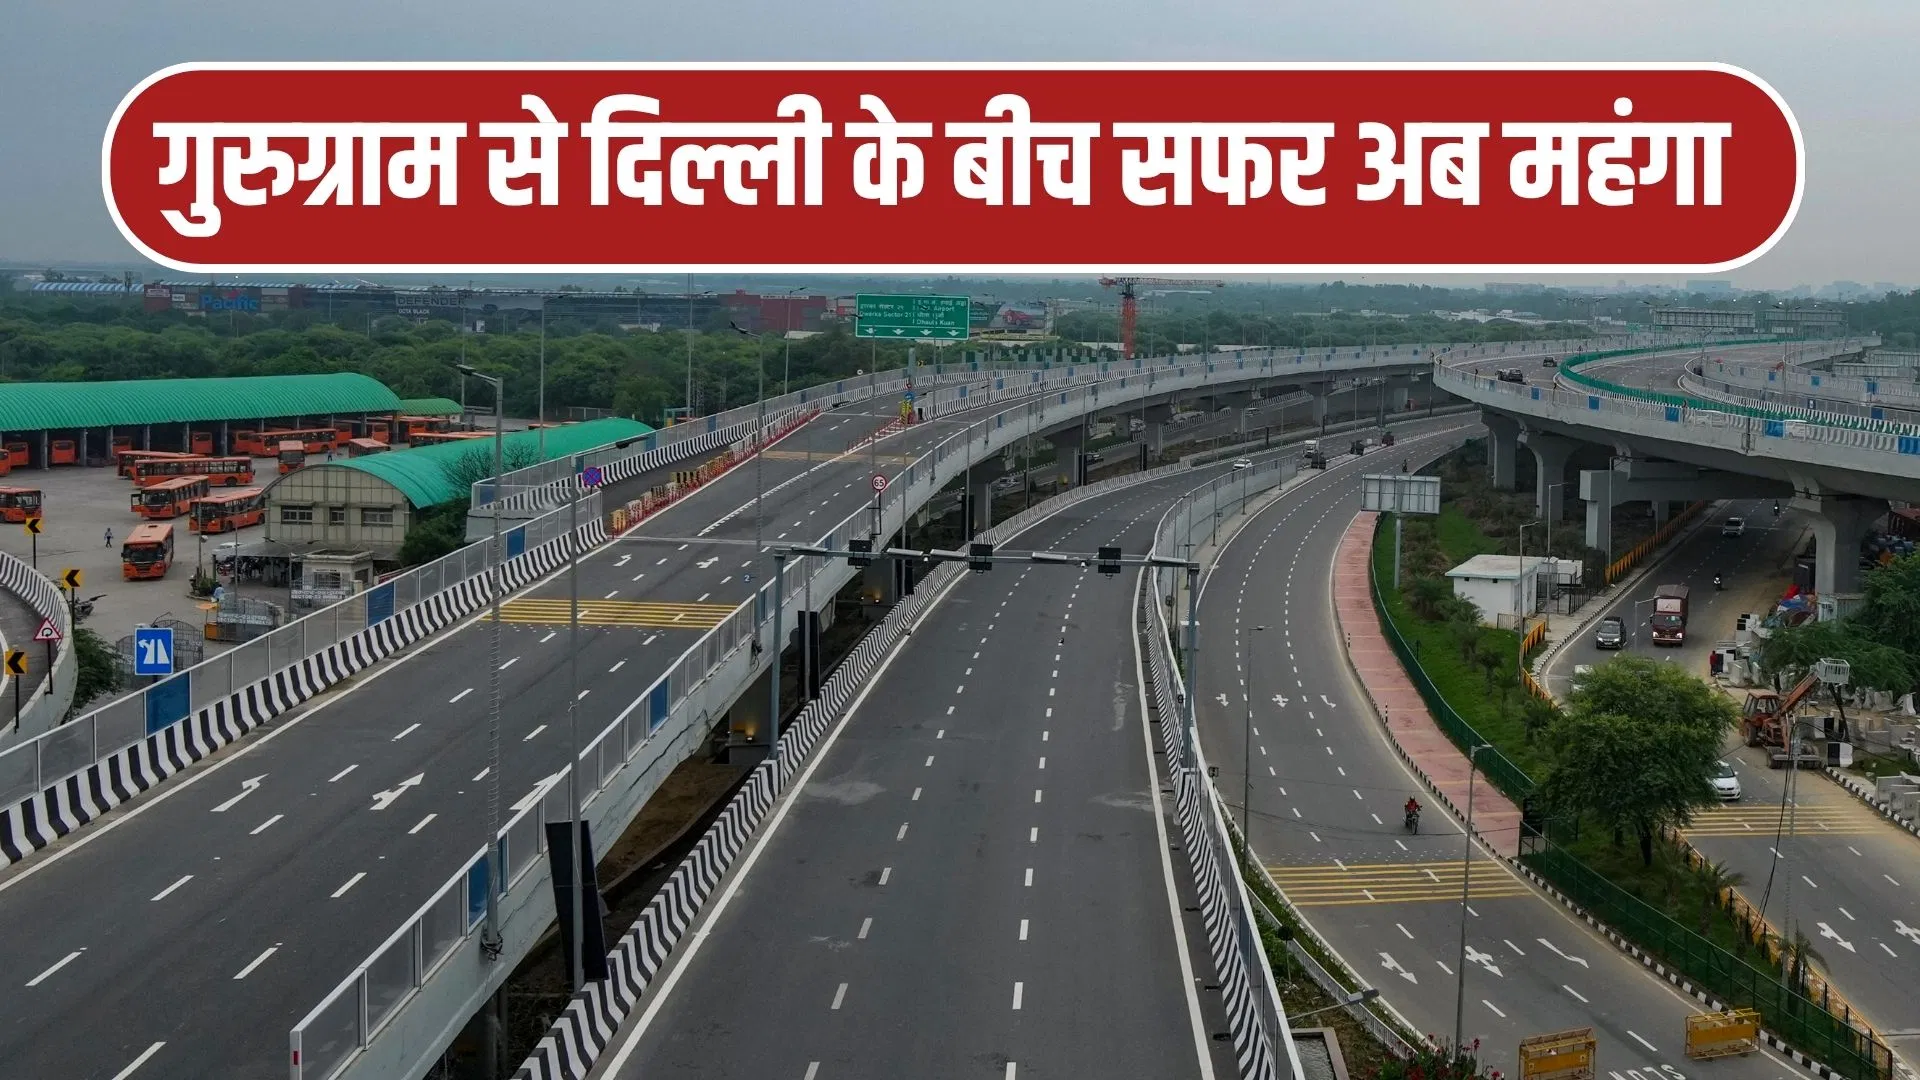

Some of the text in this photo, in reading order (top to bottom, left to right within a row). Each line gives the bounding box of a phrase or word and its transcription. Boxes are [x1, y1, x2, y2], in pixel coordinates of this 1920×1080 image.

[200, 293, 258, 310] Pacific
[933, 305, 955, 313] Airport
[874, 479, 884, 487] 65
